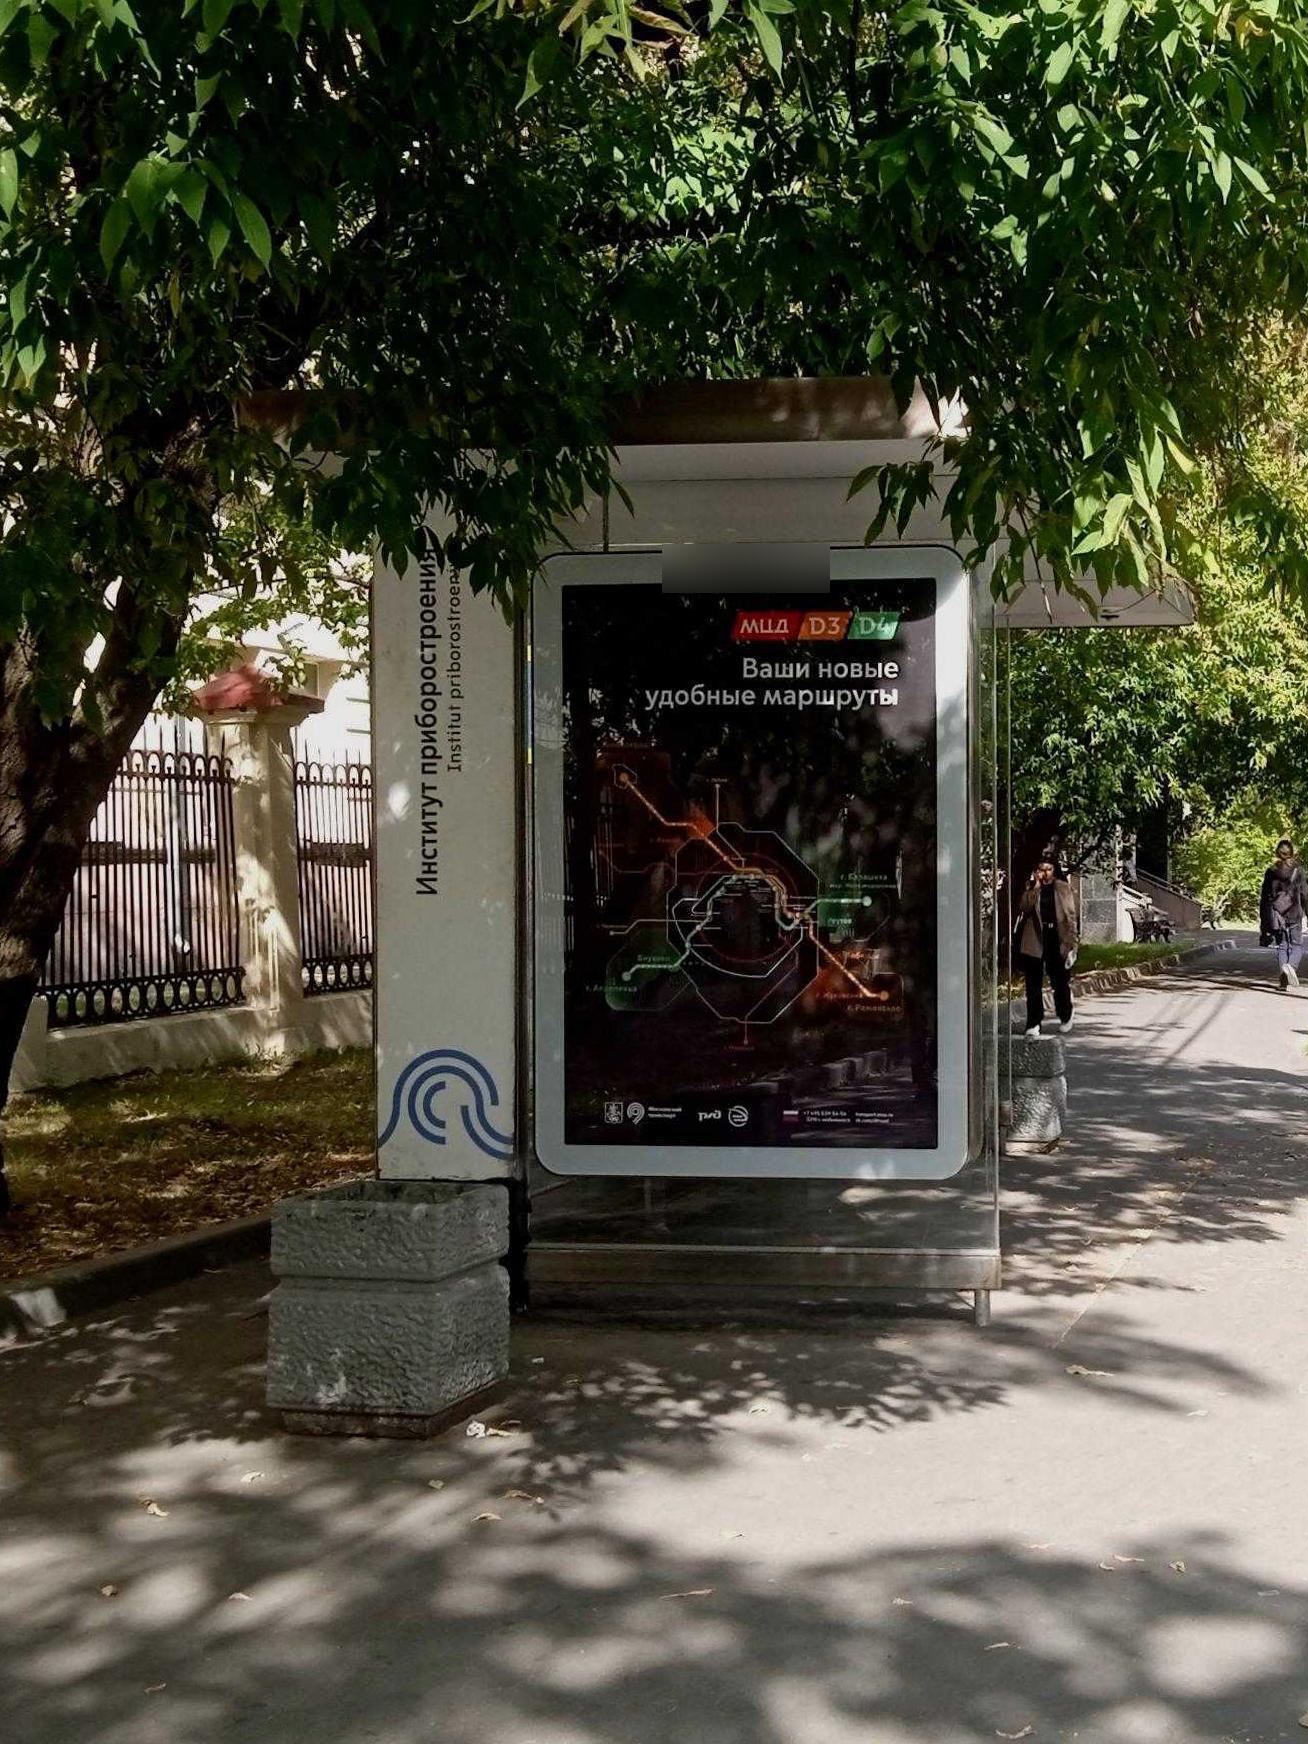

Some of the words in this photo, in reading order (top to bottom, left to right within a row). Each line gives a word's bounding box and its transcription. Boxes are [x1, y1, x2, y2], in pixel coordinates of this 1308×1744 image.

[739, 618, 789, 634] МЦД
[808, 616, 841, 635] D3
[858, 616, 895, 635] D4
[414, 547, 443, 776] приборостроения
[742, 657, 811, 679] Ваши
[818, 661, 899, 679] новые
[644, 683, 756, 711] удобные
[762, 688, 899, 711] маршруты
[447, 704, 463, 773] Institut
[416, 781, 443, 896] Институт
